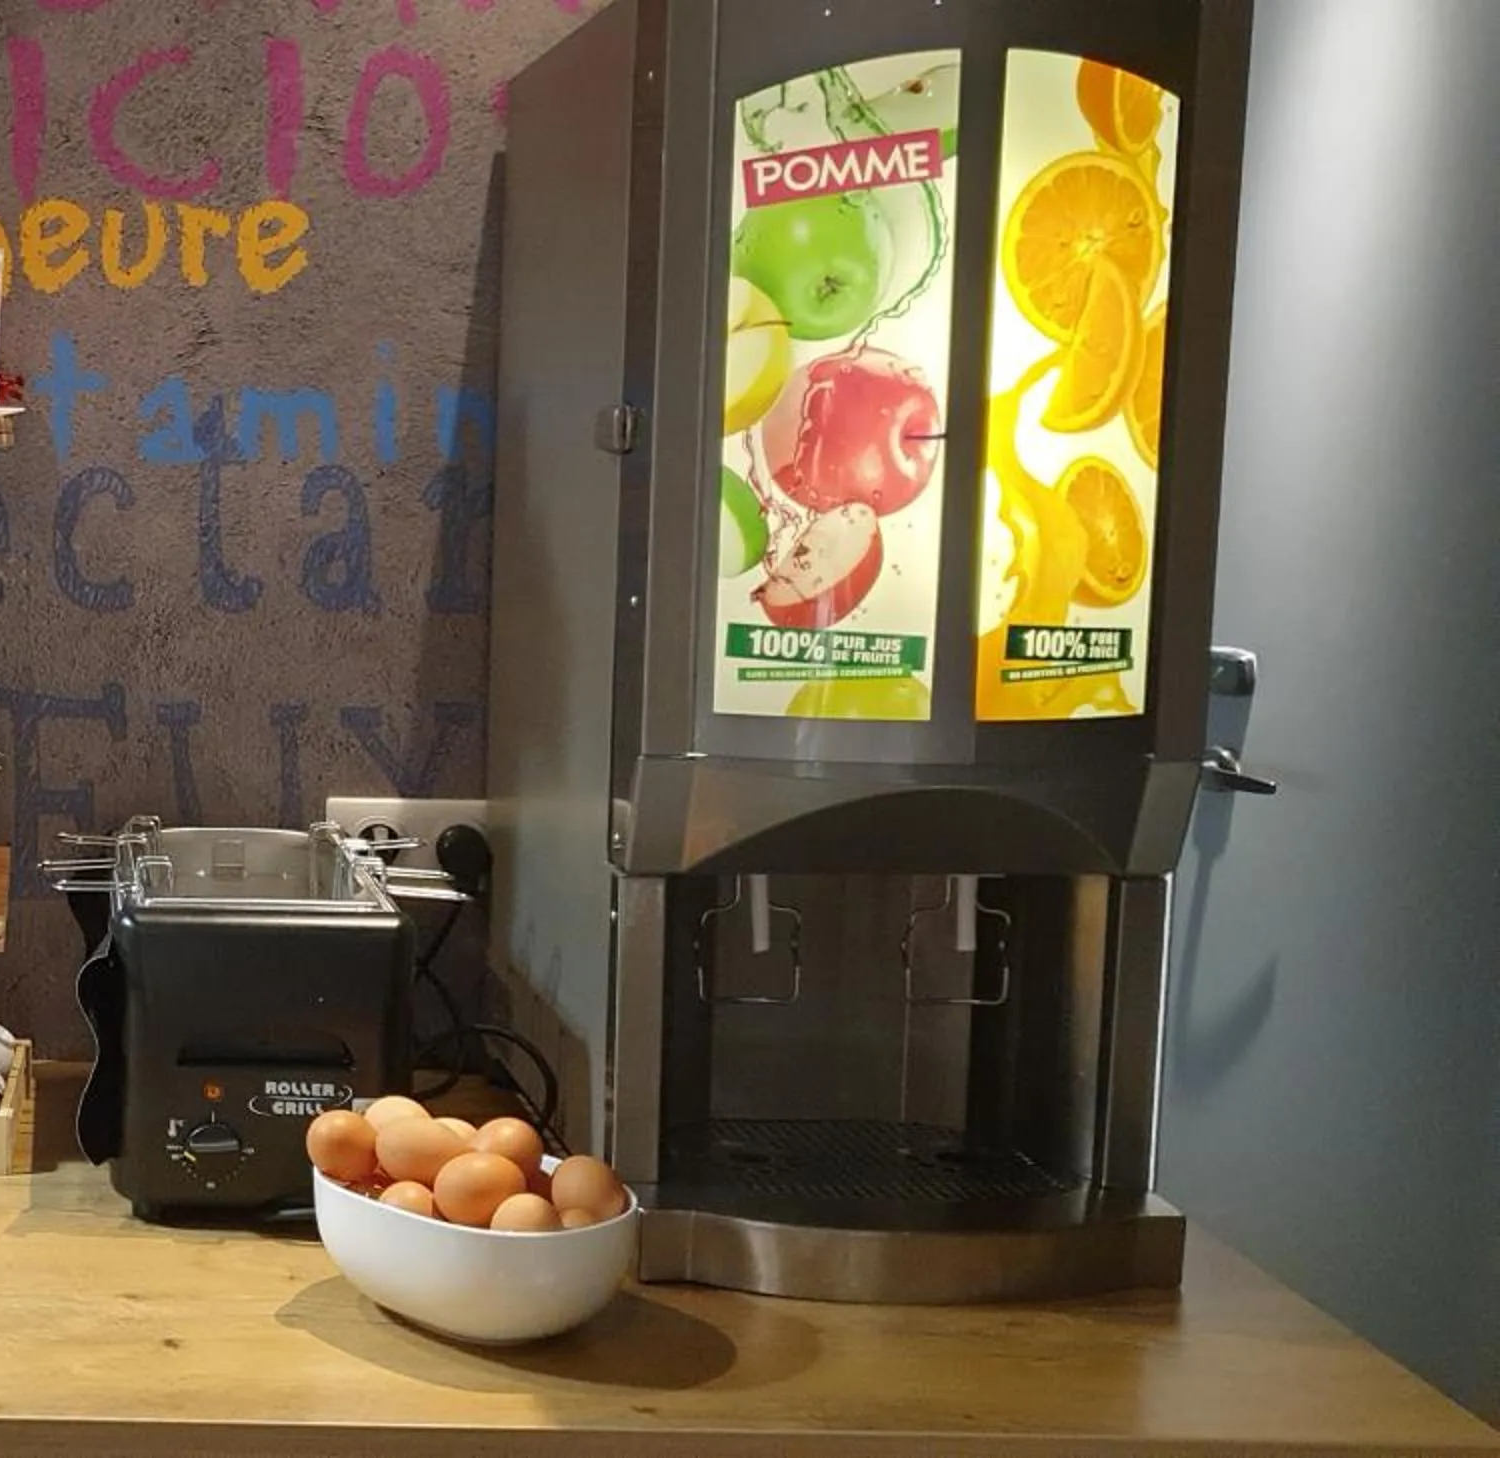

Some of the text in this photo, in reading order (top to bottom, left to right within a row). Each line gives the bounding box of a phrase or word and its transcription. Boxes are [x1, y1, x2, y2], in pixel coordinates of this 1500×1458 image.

[753, 141, 930, 196] POMME
[750, 629, 902, 661] 100% PUR JUS
[832, 650, 901, 664] DE FRUITS
[1024, 629, 1086, 659] 100%
[265, 1081, 335, 1097] ROLLER
